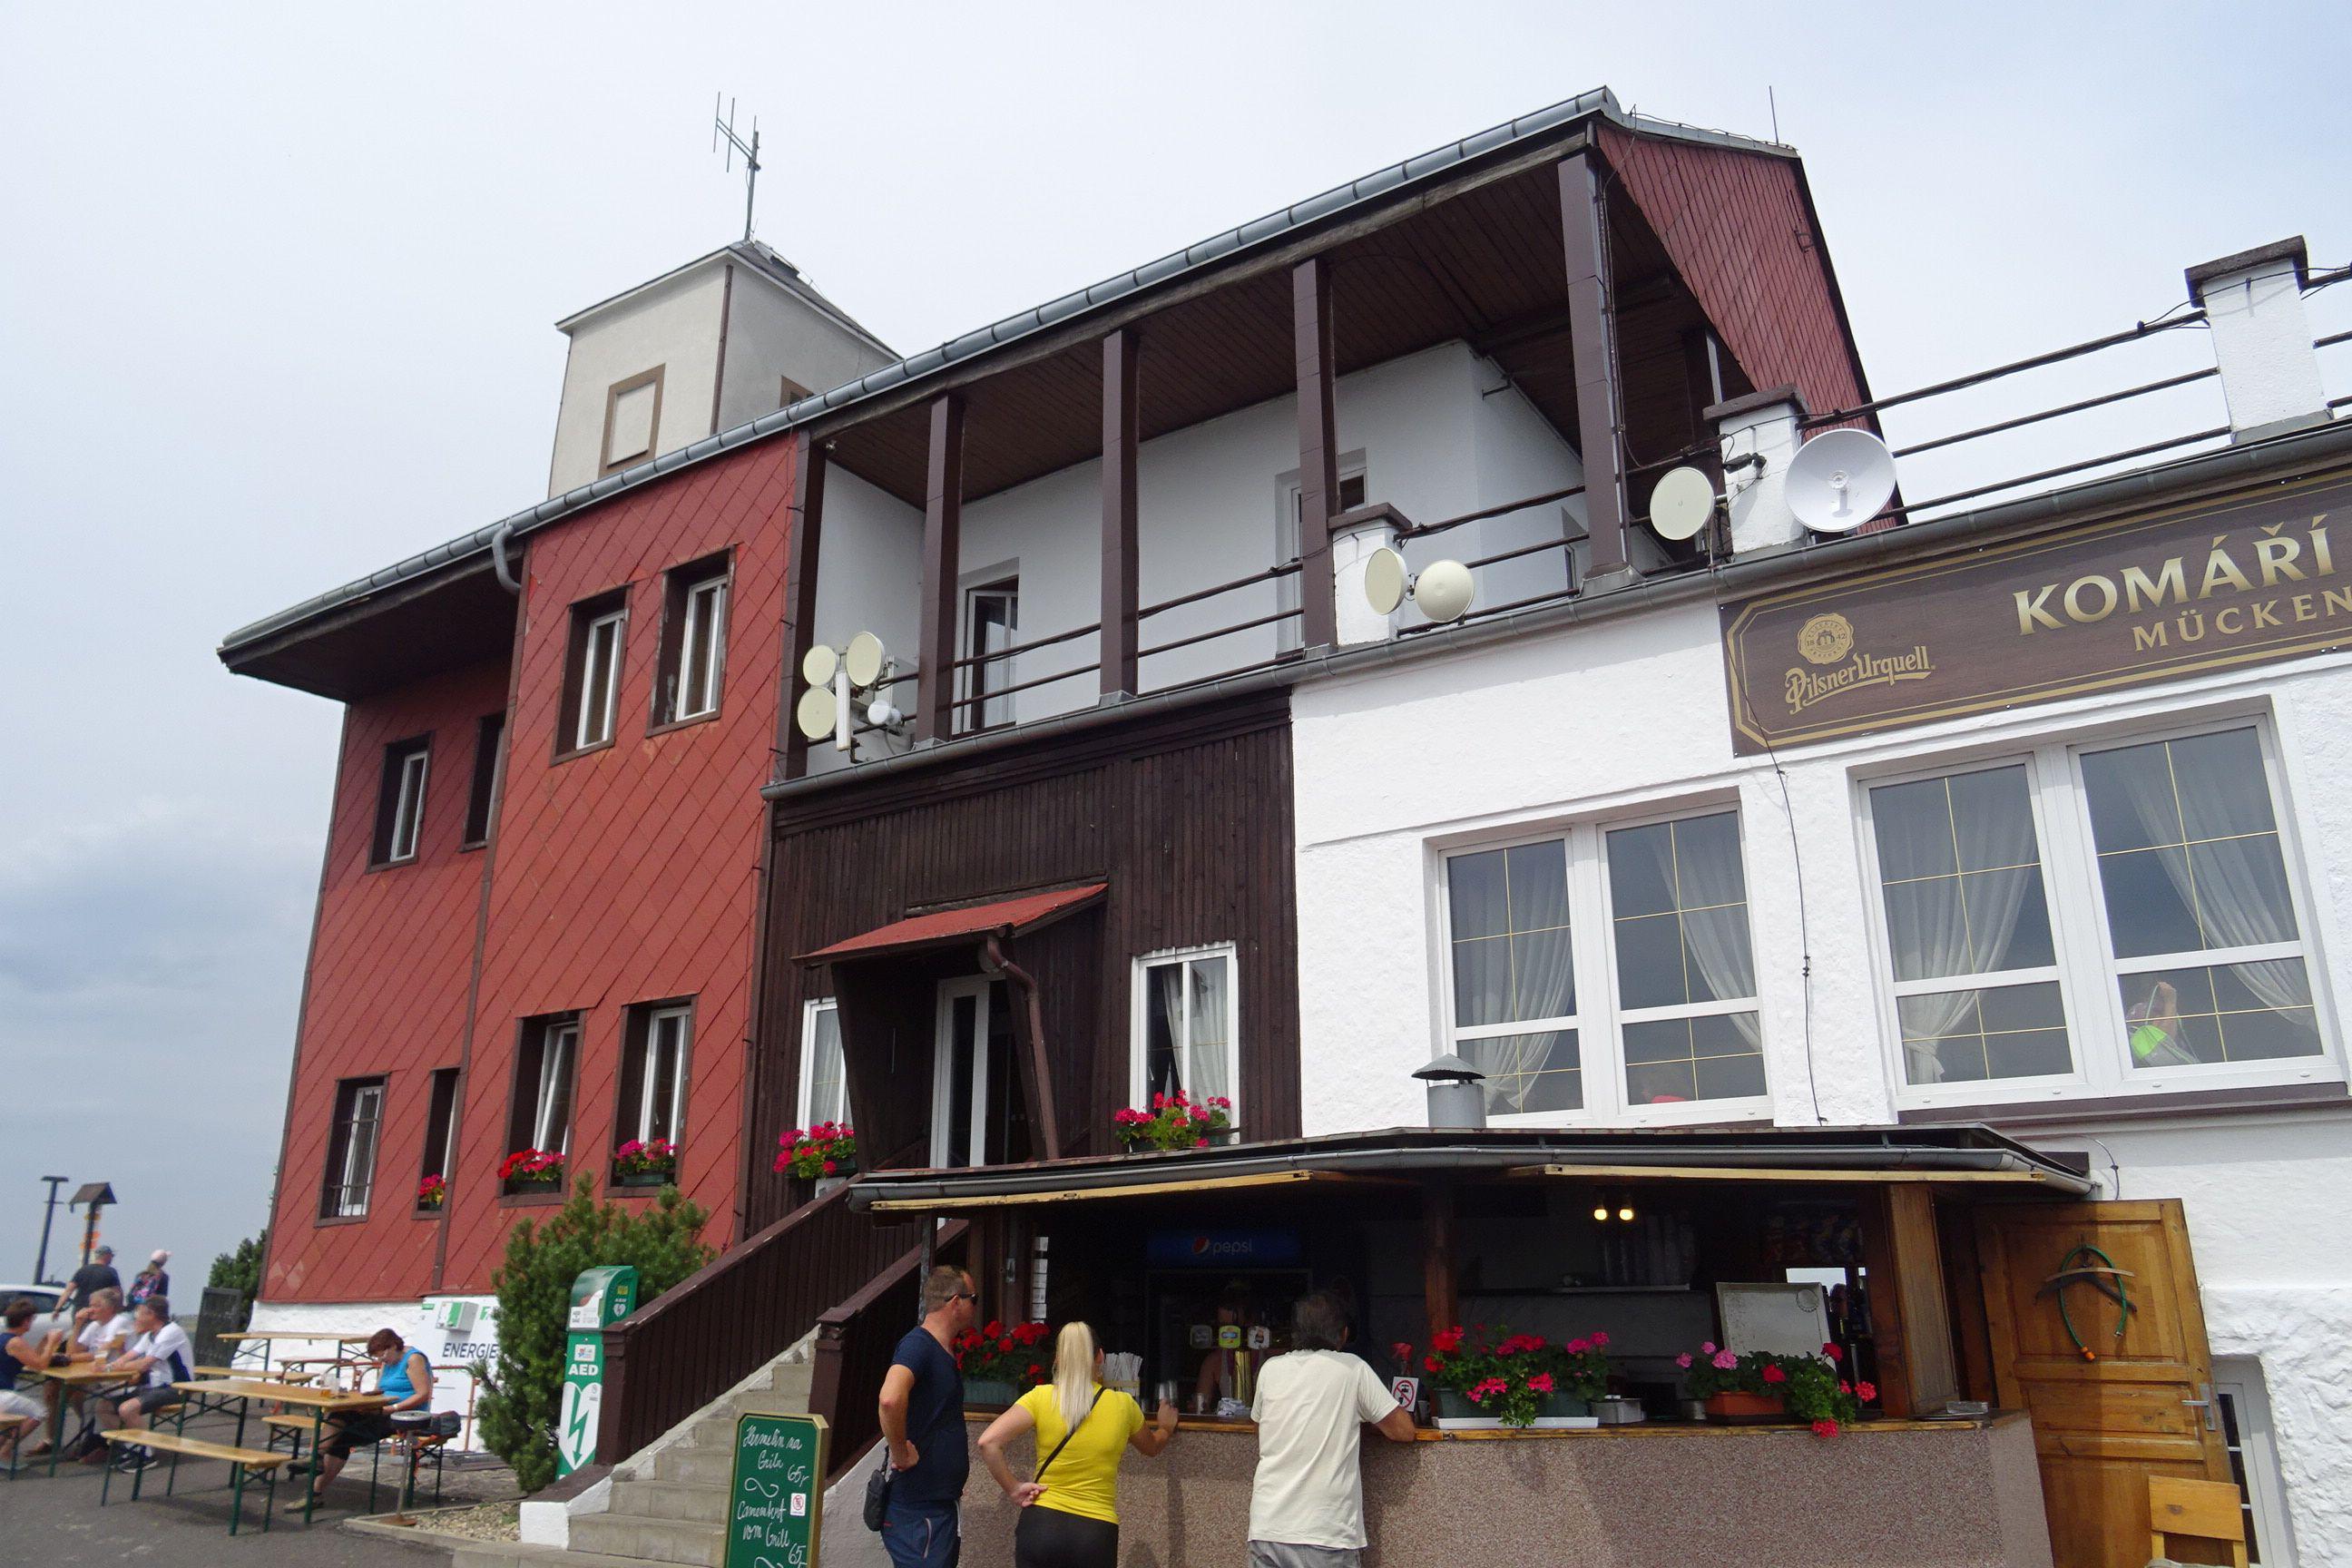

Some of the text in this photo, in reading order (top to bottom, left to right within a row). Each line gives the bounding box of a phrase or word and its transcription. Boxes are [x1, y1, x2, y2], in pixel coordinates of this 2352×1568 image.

[2013, 514, 2337, 635] KOMÁŘÍ
[2132, 585, 2352, 652] MÜCKEN
[1785, 646, 1930, 715] Pilsner Urquell
[1212, 1238, 1252, 1256] pepsi
[442, 1342, 499, 1359] ENERGIE
[568, 1363, 599, 1376] AED
[766, 1522, 790, 1548] Grill
